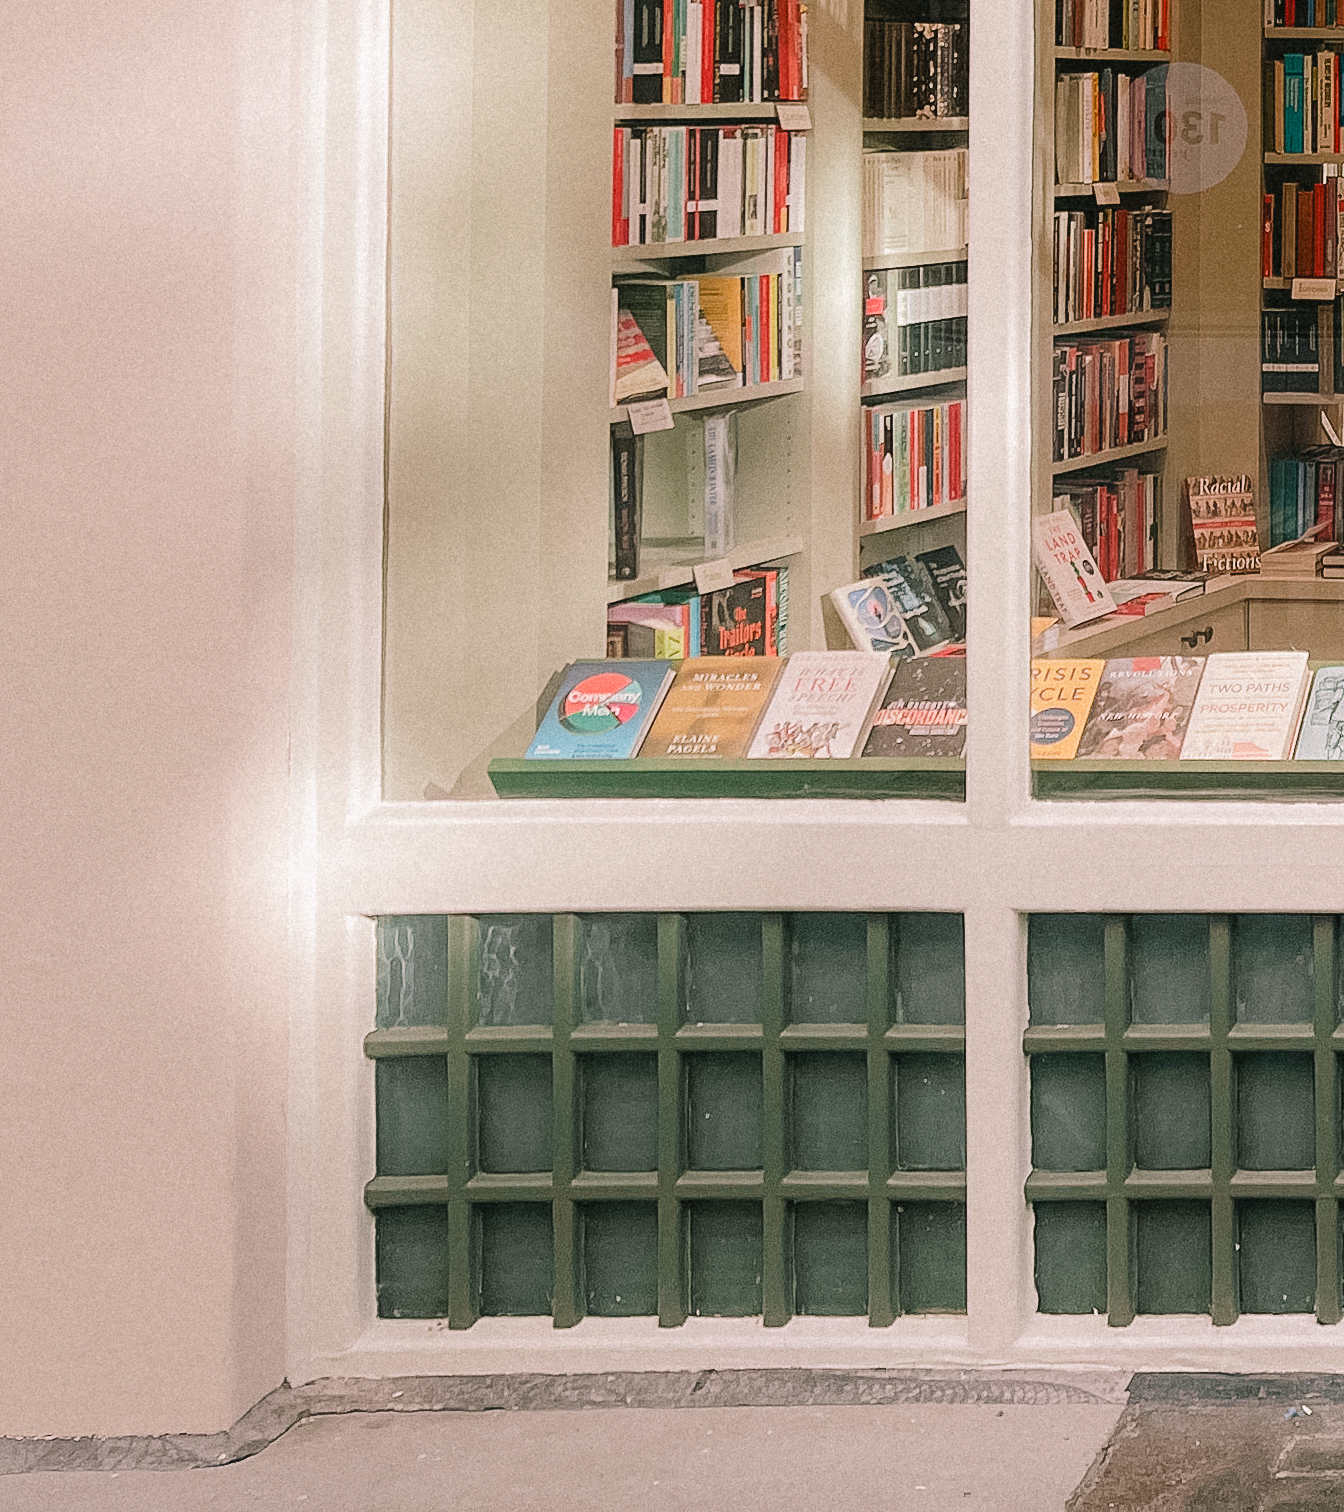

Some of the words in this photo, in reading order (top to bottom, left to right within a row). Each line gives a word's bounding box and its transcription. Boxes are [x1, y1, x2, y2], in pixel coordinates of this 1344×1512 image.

[1199, 474, 1246, 495] Racial
[1045, 532, 1076, 551] LAND
[1053, 548, 1081, 566] TRAP
[1202, 553, 1261, 572] Fictions
[692, 672, 759, 683] MIRACLES
[1032, 666, 1093, 682] RISIS
[1108, 670, 1193, 680] REVOLUTIONS
[704, 682, 763, 691] WONDER
[794, 677, 857, 692] FREE
[1209, 683, 1242, 694] TWO
[1246, 682, 1290, 693] PATHS
[567, 691, 642, 705] Company
[581, 703, 621, 717] Man
[1200, 702, 1289, 715] PROSPERITY
[872, 708, 968, 726] DISCORDANC
[672, 734, 721, 744] ELAINE
[666, 744, 718, 755] PAGELS
